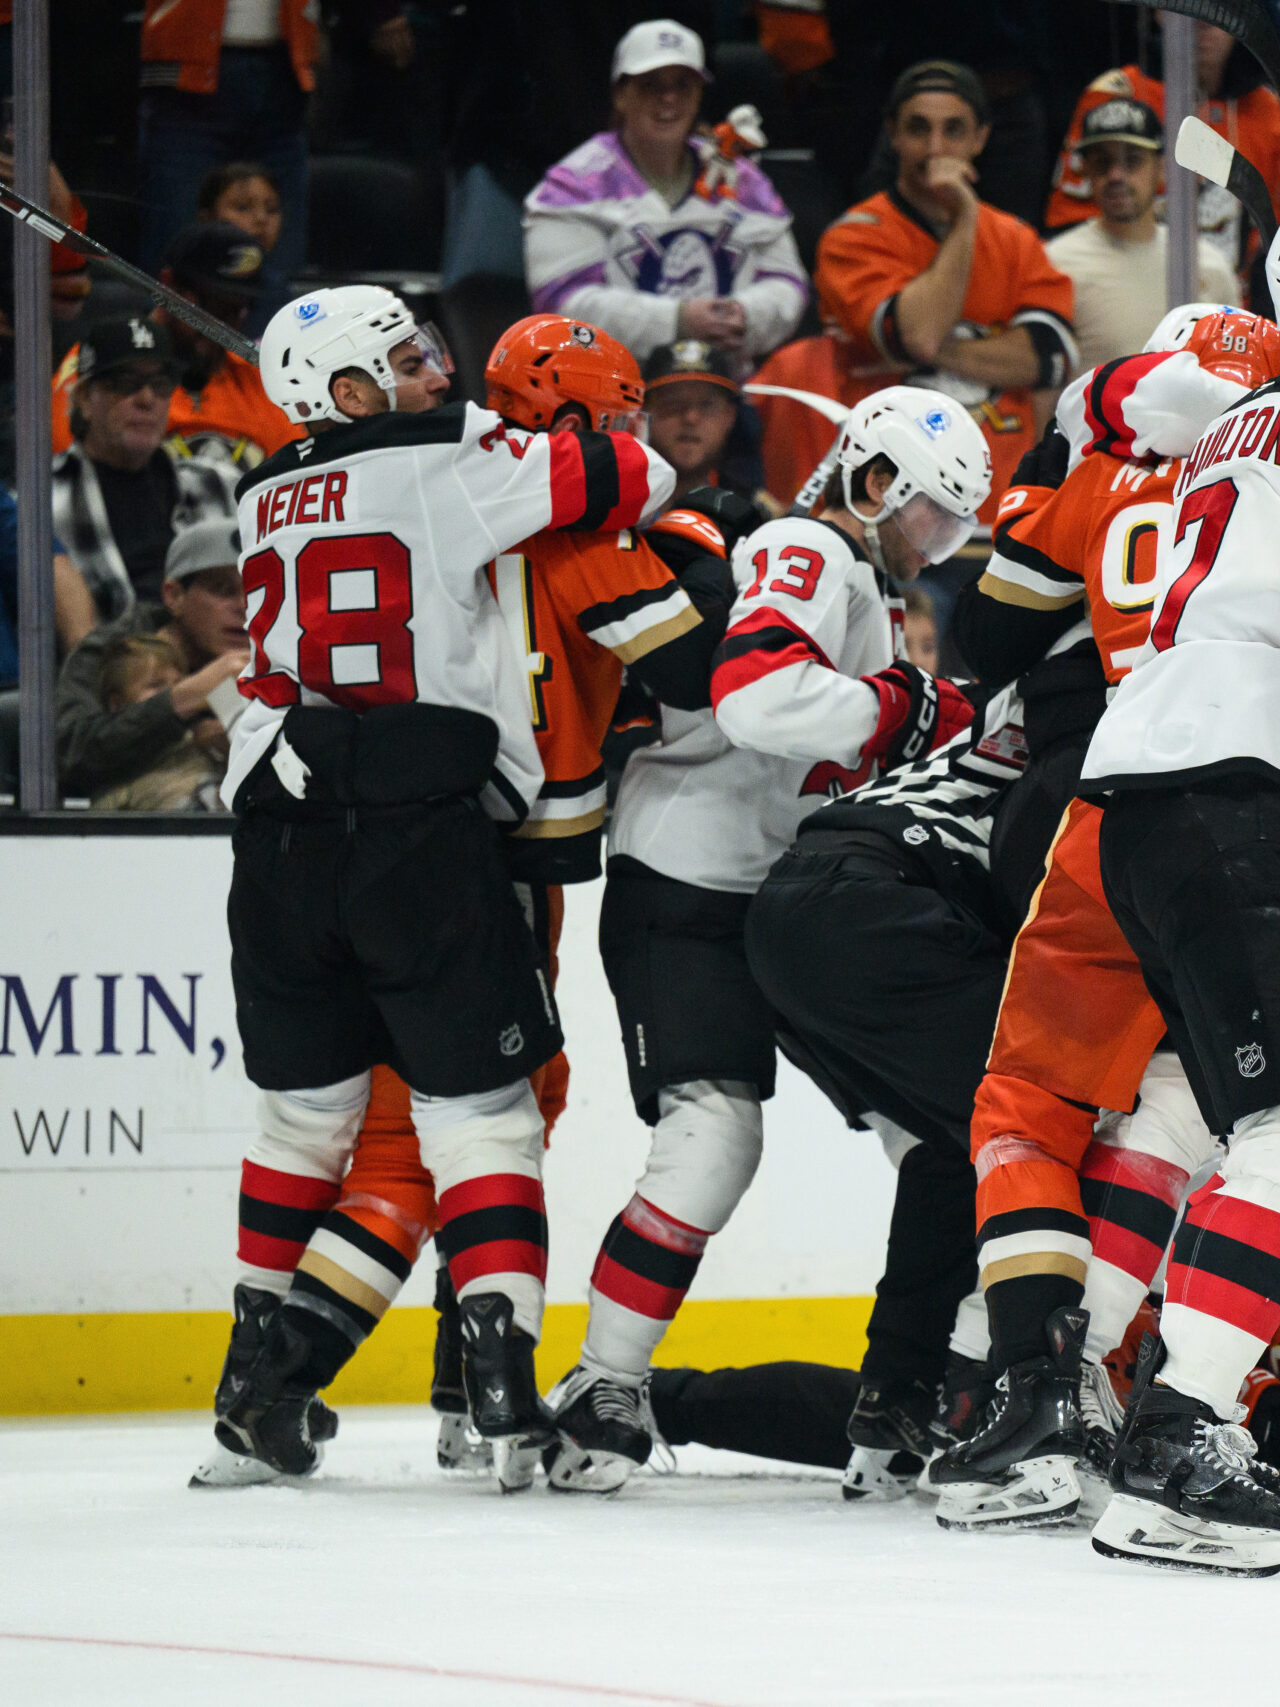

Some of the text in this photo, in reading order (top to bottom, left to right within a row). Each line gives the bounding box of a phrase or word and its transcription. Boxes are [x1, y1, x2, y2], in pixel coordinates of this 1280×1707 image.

[1221, 335, 1248, 353] 98
[256, 470, 348, 545] MEIER
[743, 545, 826, 601] 13
[1150, 476, 1240, 653] 7
[237, 531, 420, 715] 28
[901, 666, 938, 760] CCM
[0, 972, 227, 1072] MIN,
[13, 1107, 144, 1156] WIN
